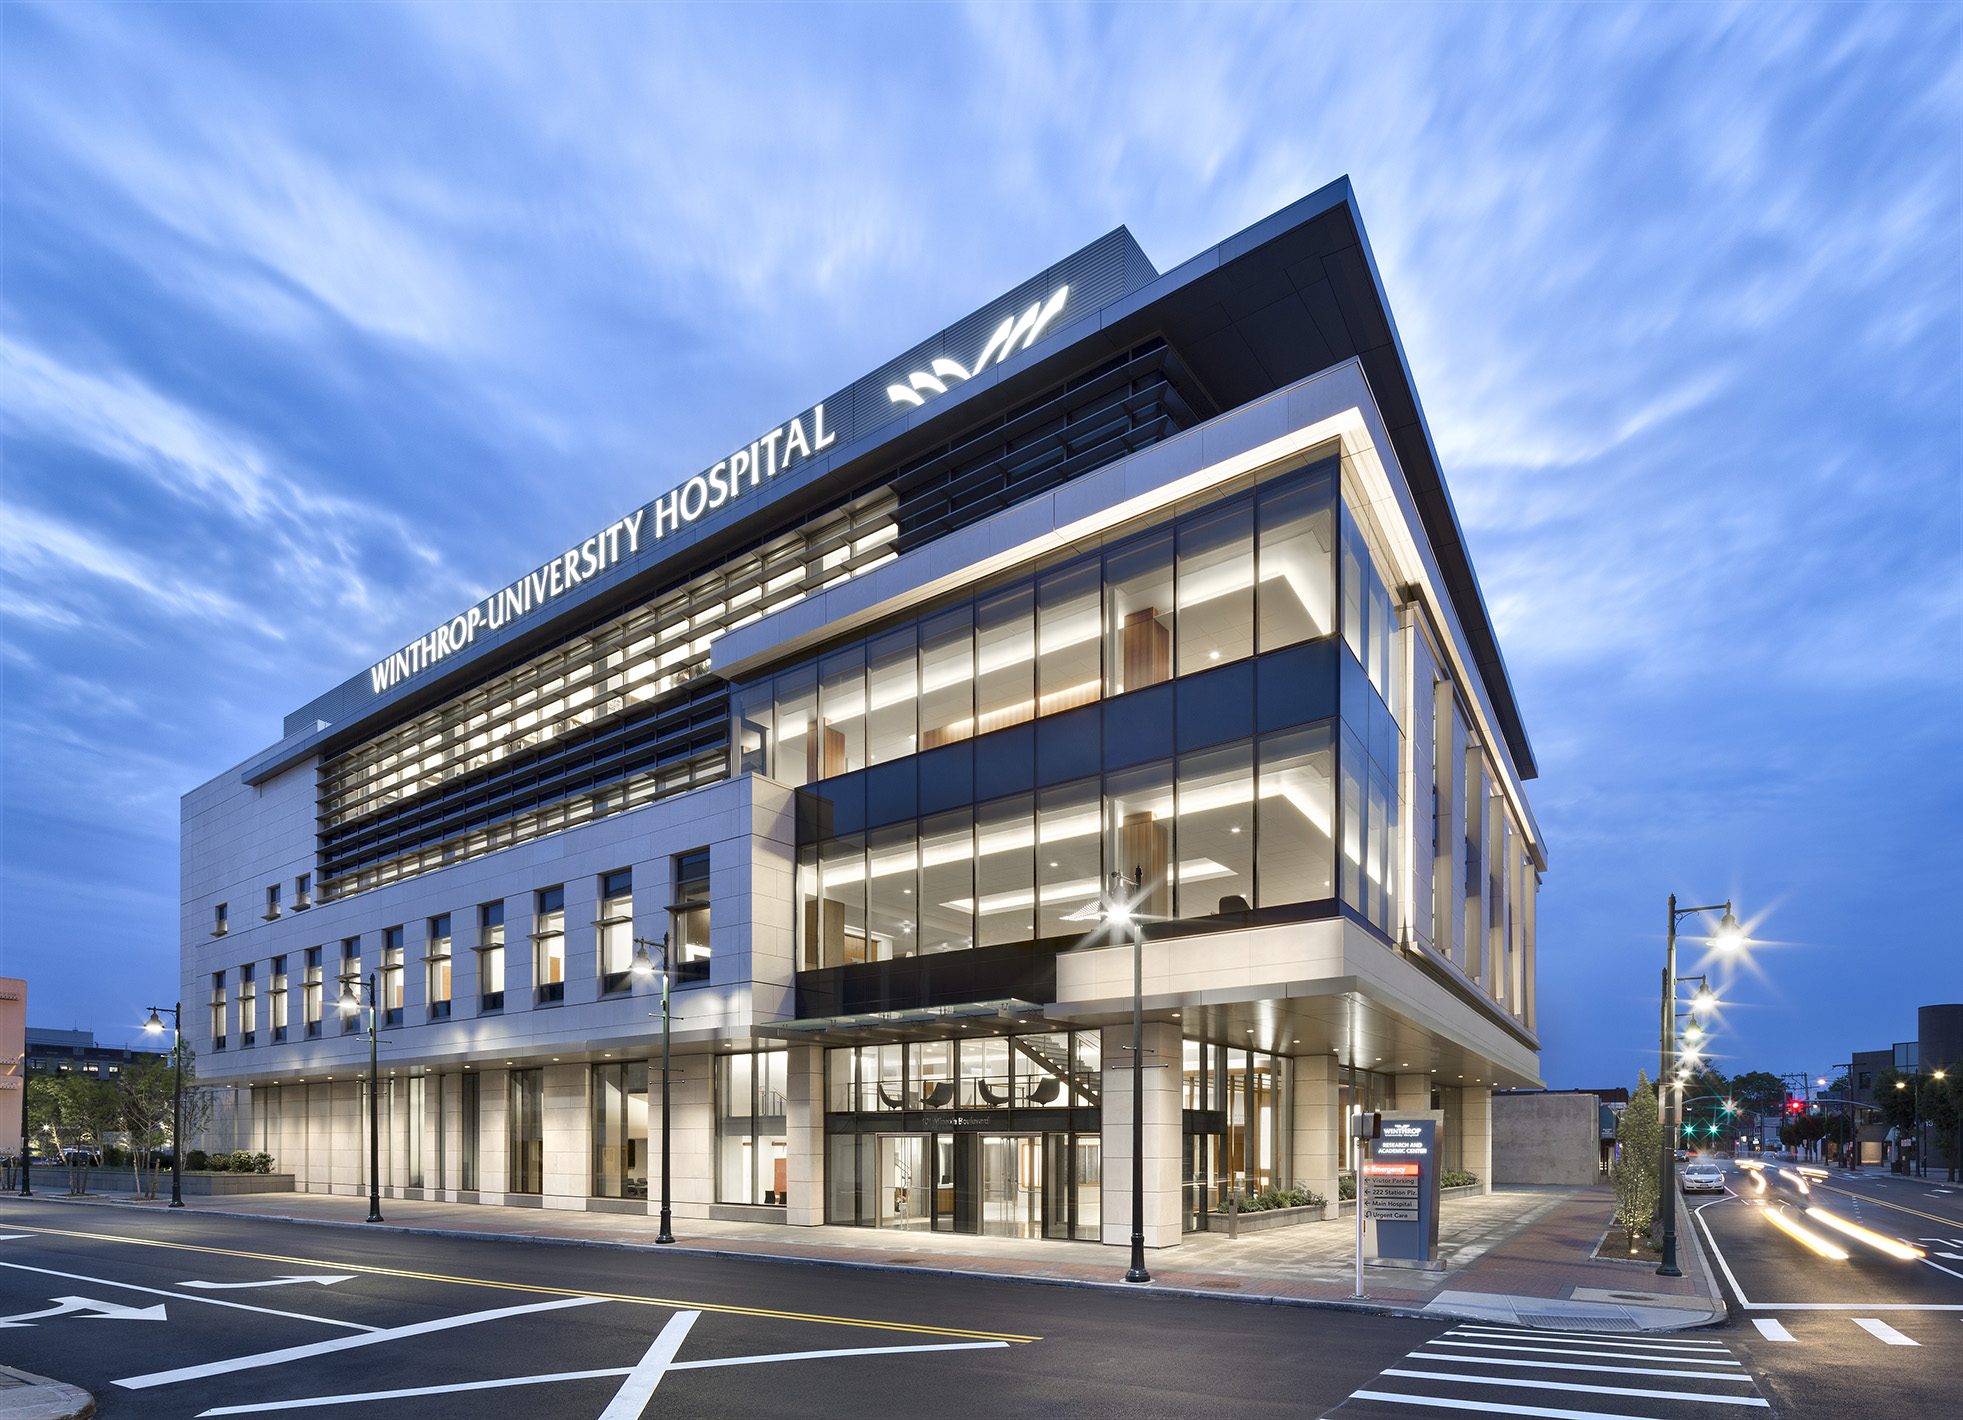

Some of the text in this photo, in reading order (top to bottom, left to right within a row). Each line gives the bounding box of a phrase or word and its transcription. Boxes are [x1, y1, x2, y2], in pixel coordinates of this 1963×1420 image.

[371, 404, 836, 694] WINTHROP-UNIVERSITY HOSPITAL
[1371, 1165, 1406, 1174] Emergency
[1392, 1177, 1415, 1185] Parking
[1372, 1211, 1393, 1219] Urgent
